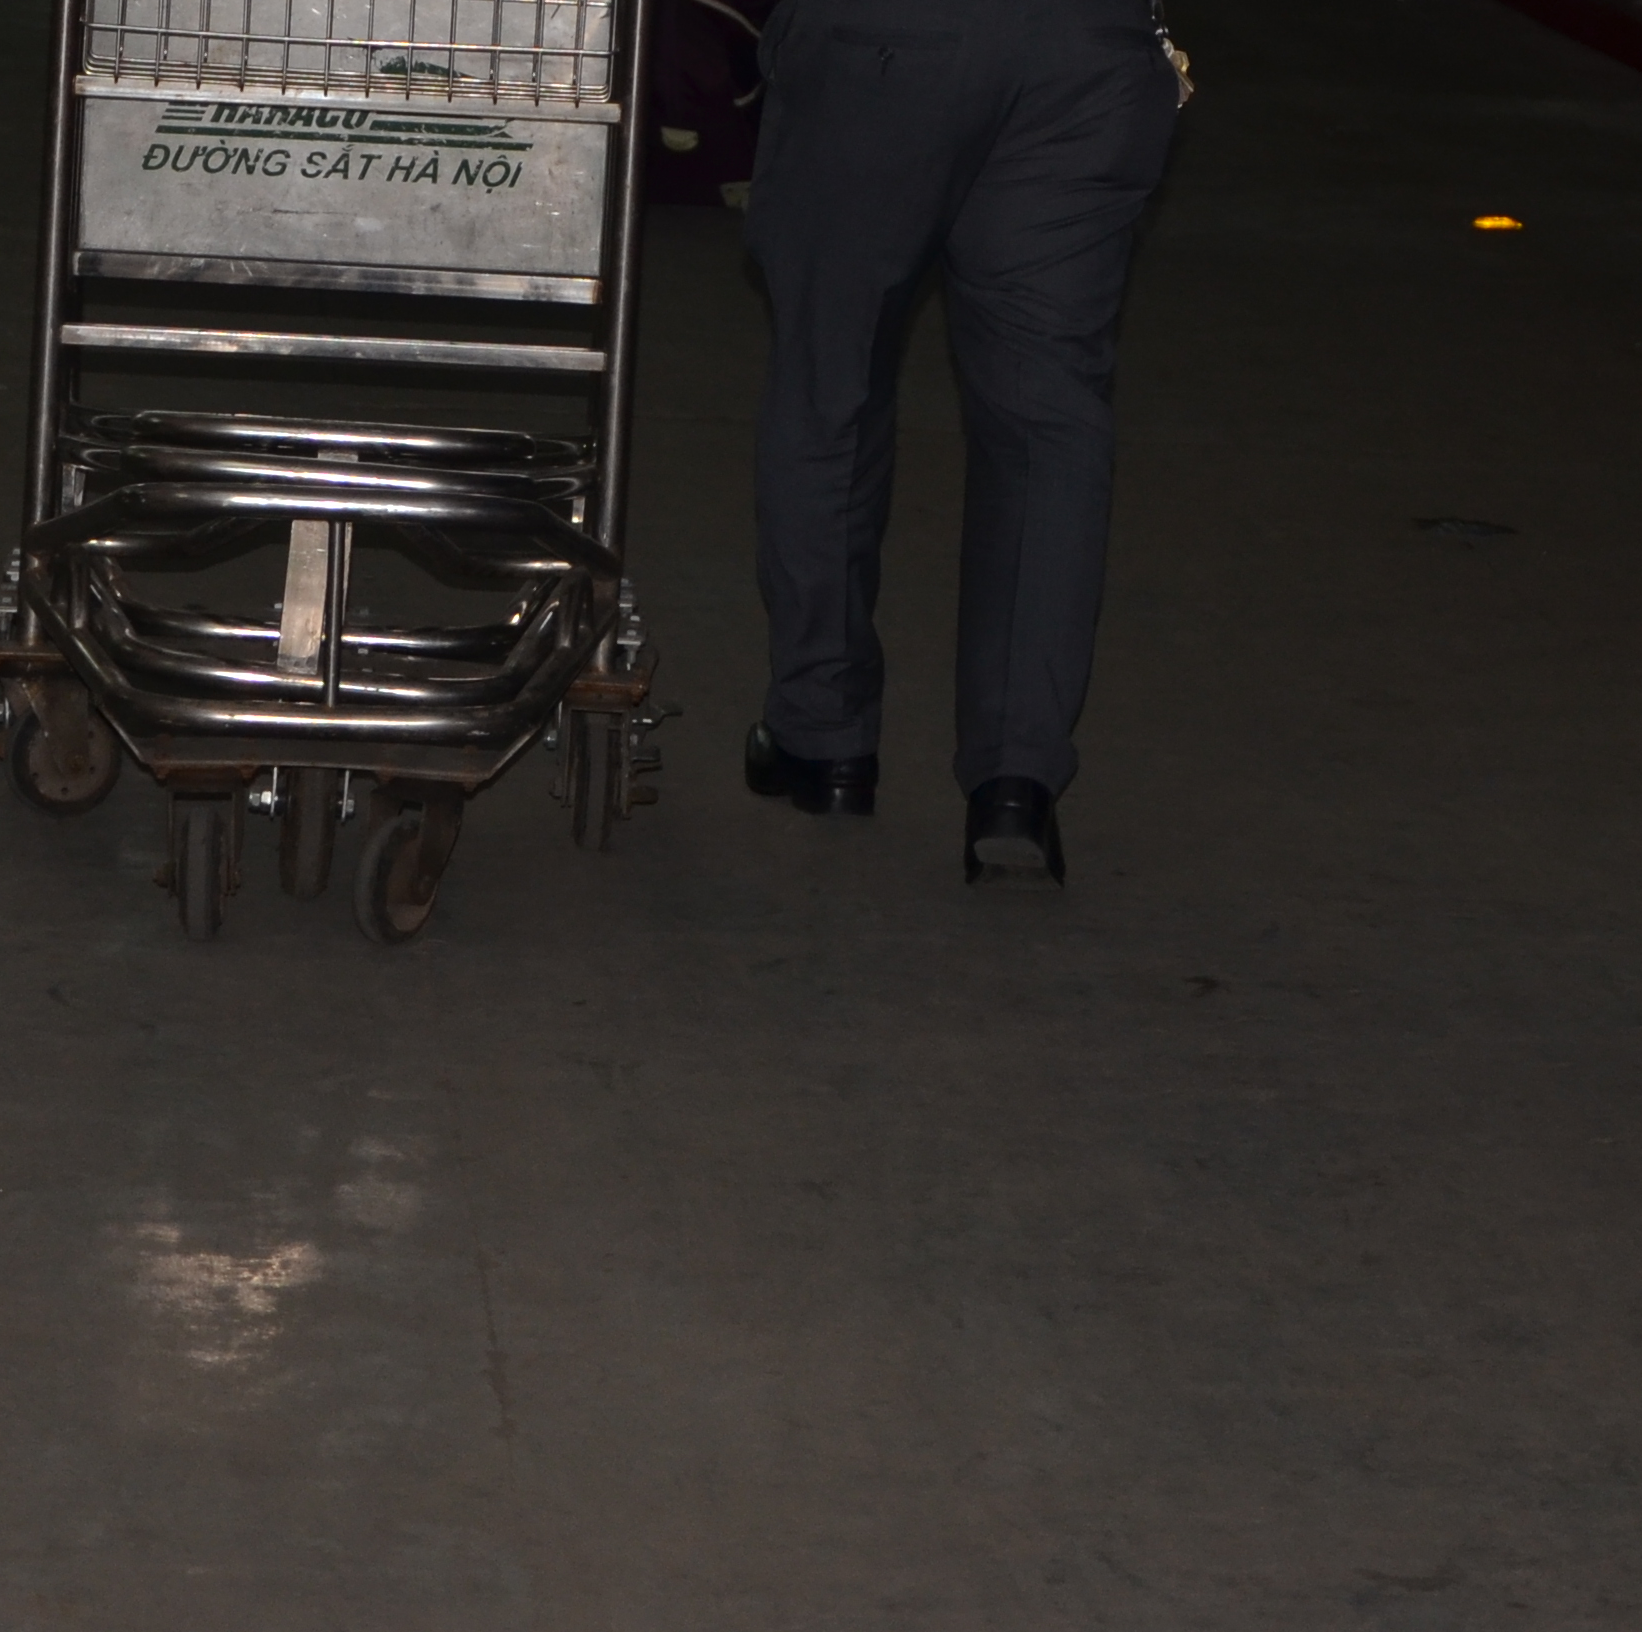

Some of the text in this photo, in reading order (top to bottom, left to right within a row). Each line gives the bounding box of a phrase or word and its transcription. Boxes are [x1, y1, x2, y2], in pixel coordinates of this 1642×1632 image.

[141, 138, 524, 194] ĐƯỜNG SẮT HÀ NỘI
